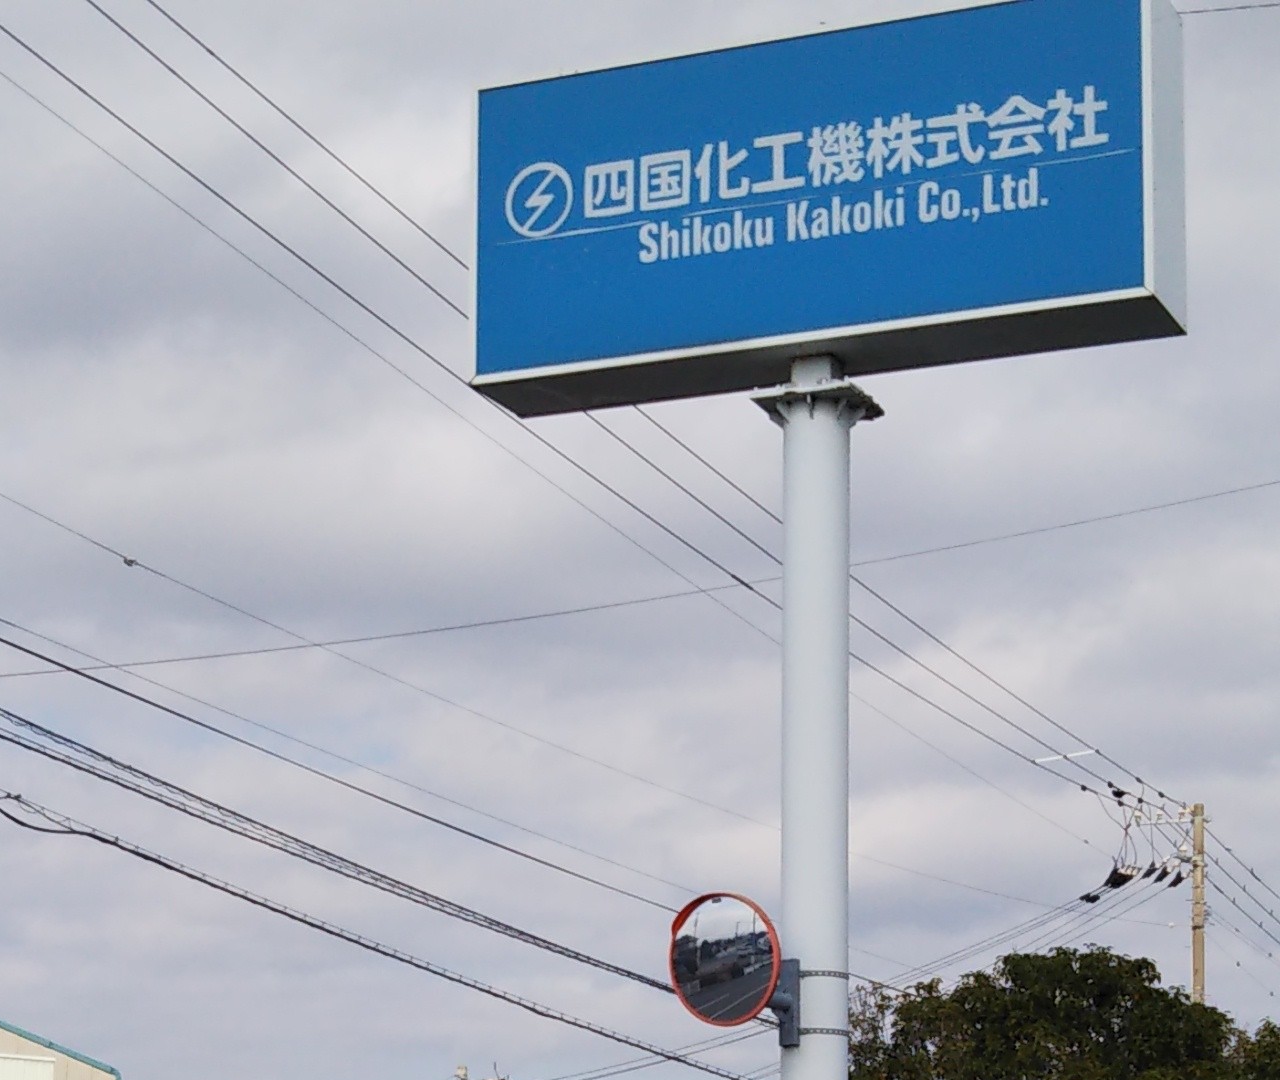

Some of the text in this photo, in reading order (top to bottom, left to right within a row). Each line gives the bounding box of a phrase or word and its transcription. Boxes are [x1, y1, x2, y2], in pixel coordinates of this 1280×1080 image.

[583, 84, 1110, 220] 四国化工機株式会社
[637, 211, 774, 264] Shikoku
[786, 194, 906, 243] Kakoki
